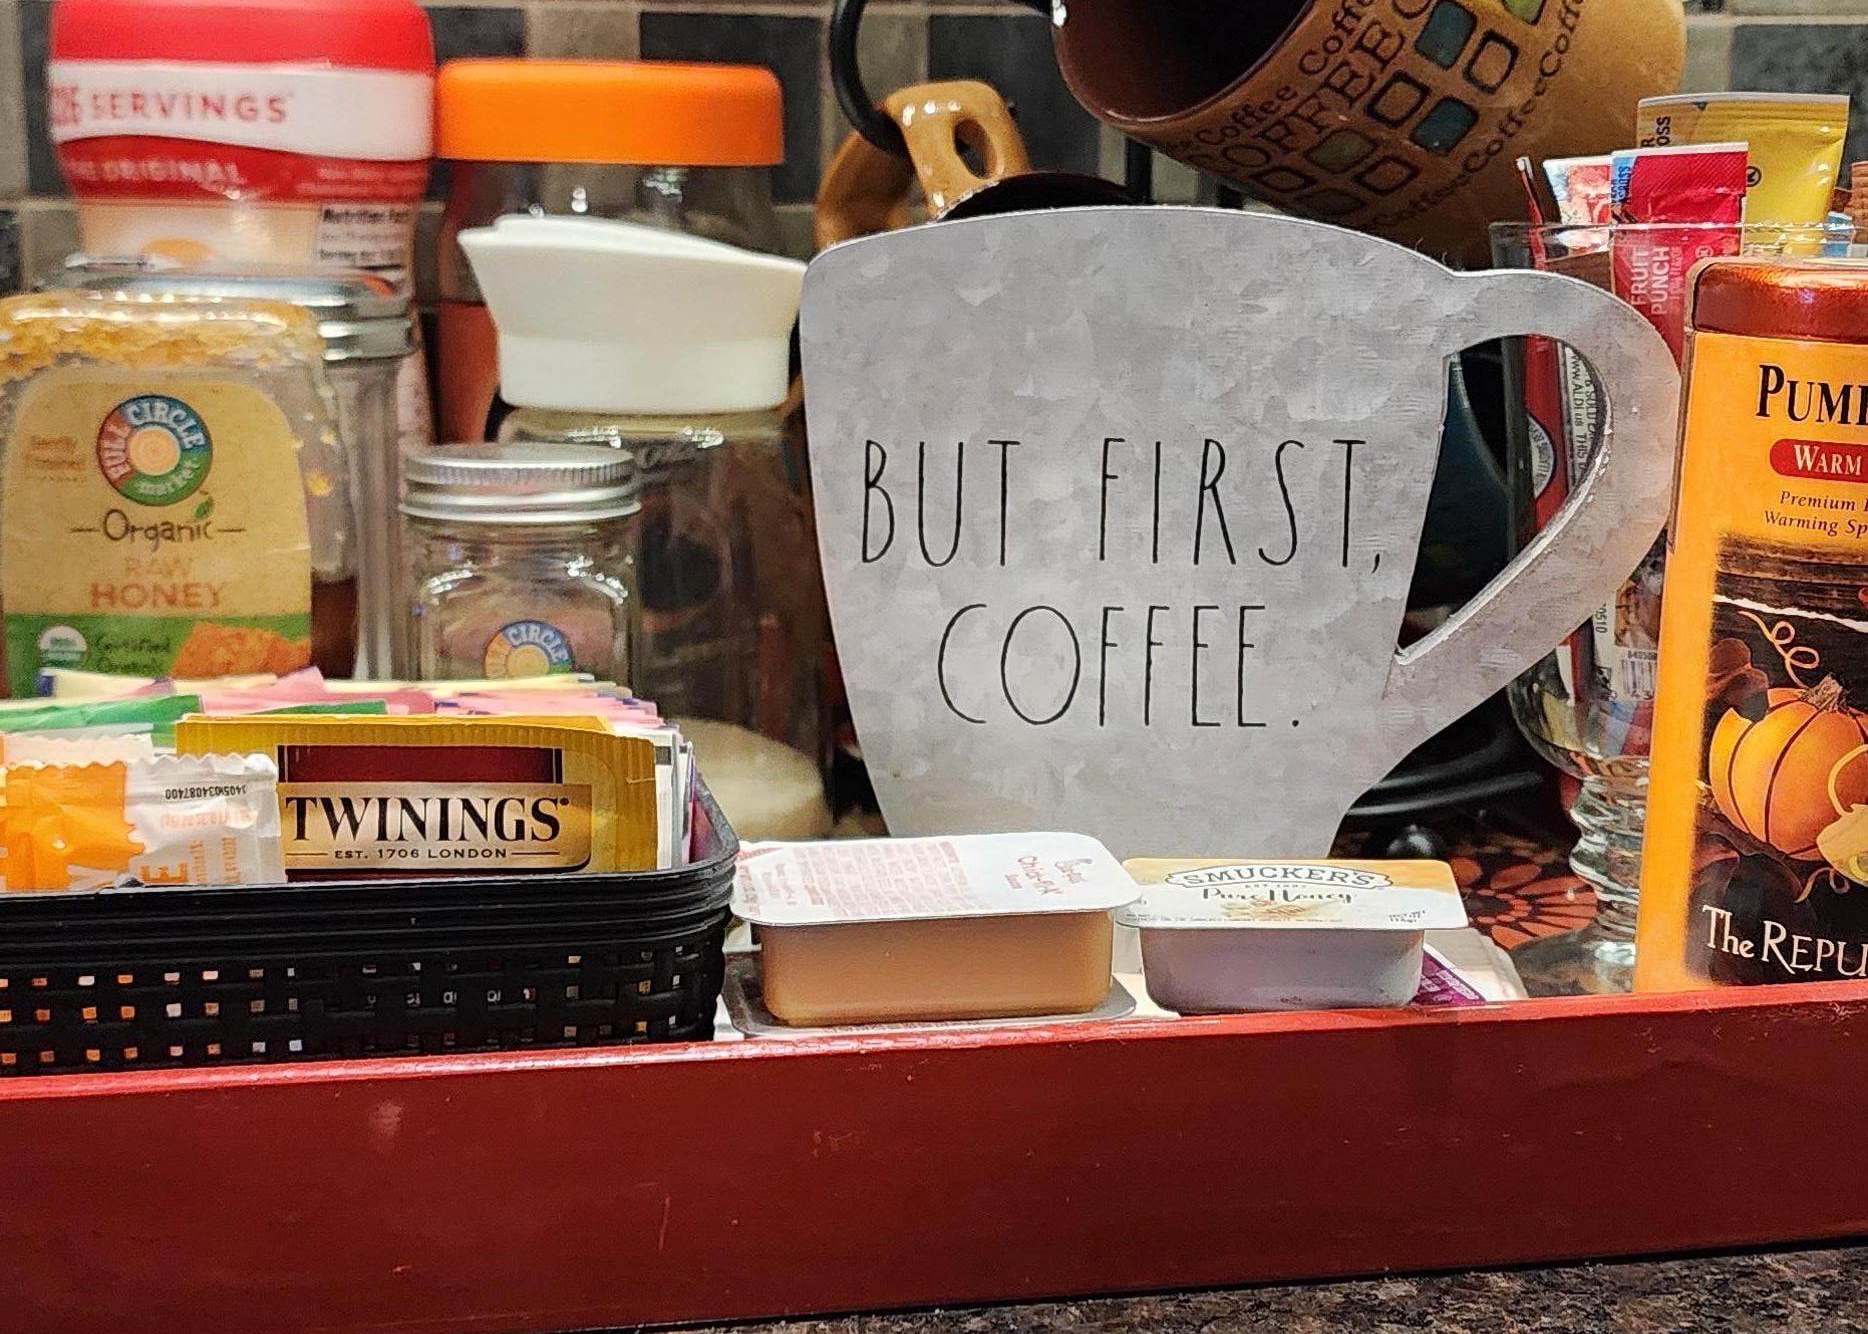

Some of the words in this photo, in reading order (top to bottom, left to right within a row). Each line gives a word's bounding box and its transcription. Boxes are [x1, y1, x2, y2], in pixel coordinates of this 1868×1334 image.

[92, 90, 288, 123] SERVINGS
[1630, 246, 1650, 305] FRUIT
[1650, 246, 1670, 316] PUNCH
[1755, 363, 1868, 426] PUM
[102, 423, 131, 479] FULL
[126, 401, 206, 449] CIRCLE
[1793, 444, 1863, 476] WARM
[860, 440, 1022, 567] BUT
[1098, 437, 1382, 574] FIRST,
[1779, 490, 1857, 513] Premium
[104, 509, 213, 553] Organic
[1764, 509, 1839, 537] Warming
[124, 555, 195, 579] RAW
[89, 581, 230, 609] HONEY
[505, 621, 571, 663] CIRCLE
[937, 602, 1301, 727] COFFEE.
[285, 796, 562, 843] TWININGS
[334, 850, 369, 860] EST.
[378, 848, 421, 859] 1706
[428, 847, 507, 859] LONDON
[1183, 866, 1376, 887] SMUCKER'S
[1268, 888, 1352, 904] Honey
[1701, 903, 1756, 959] The
[1760, 919, 1868, 978] REPU
